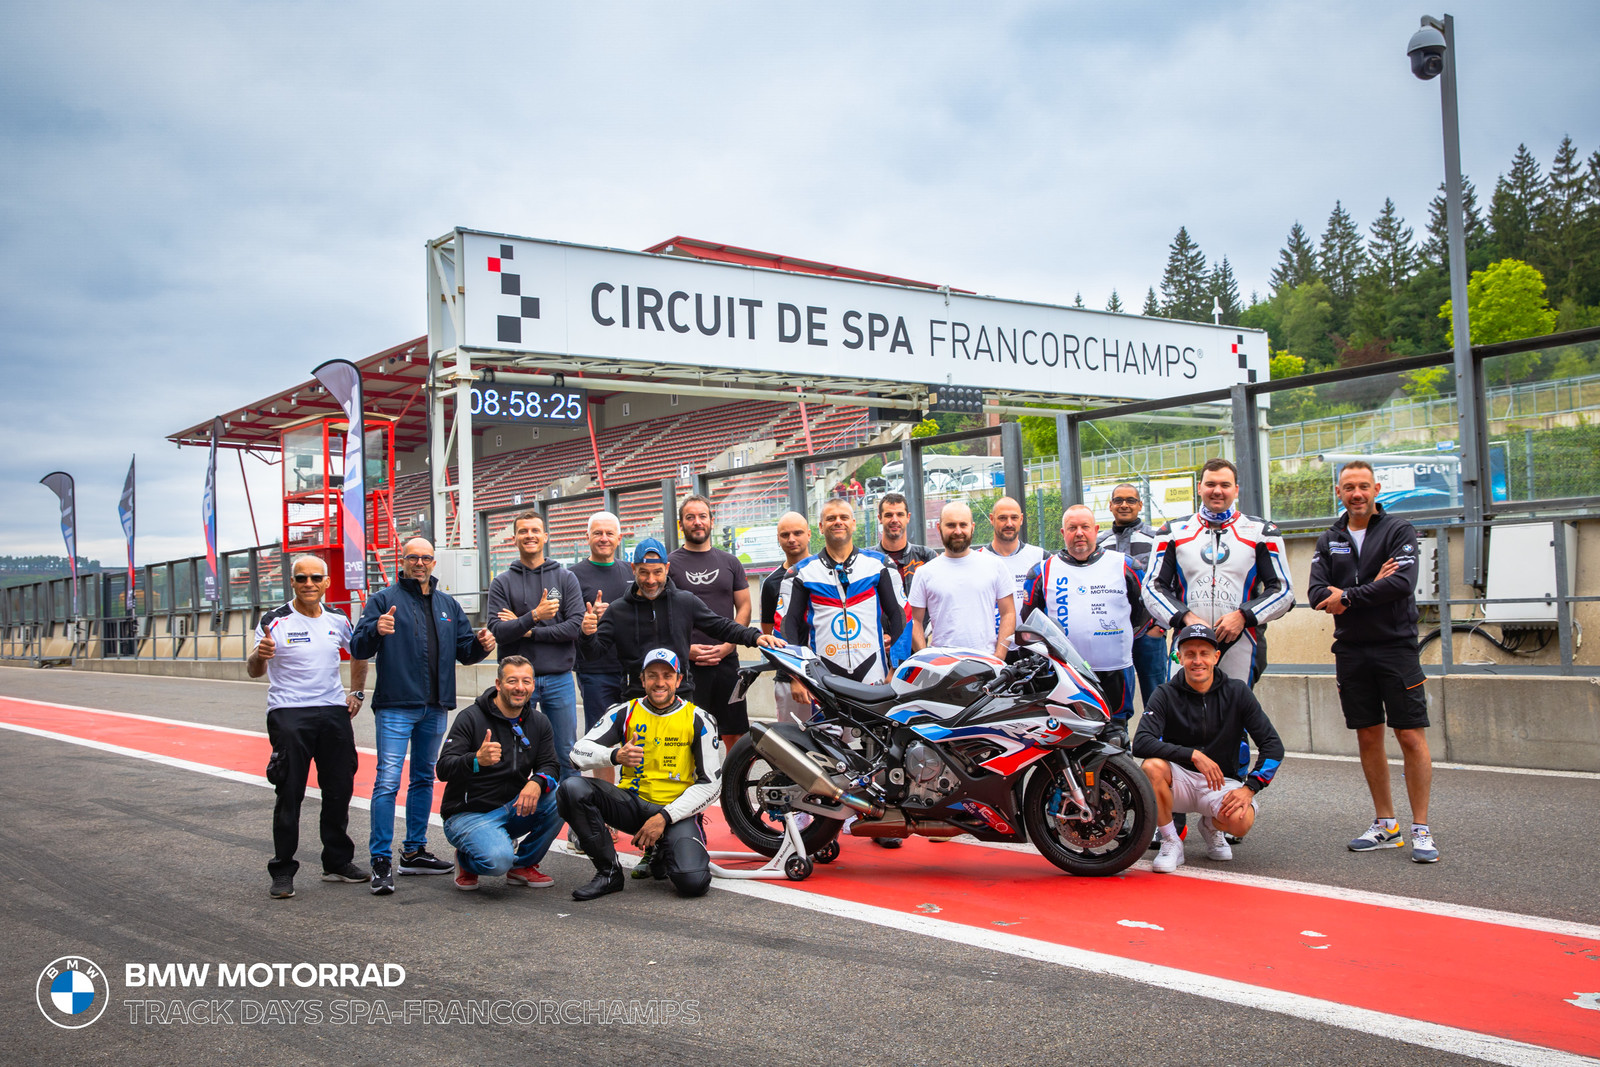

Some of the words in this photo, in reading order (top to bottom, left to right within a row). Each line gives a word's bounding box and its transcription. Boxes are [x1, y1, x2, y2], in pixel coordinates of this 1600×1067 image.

[590, 282, 763, 340] CIRCUIT
[777, 302, 829, 347] DE
[842, 310, 914, 355] SPA
[929, 319, 1198, 380] FRANCORCHAMPS
[471, 388, 582, 419] 08:58:25
[1190, 590, 1237, 601] EVASION
[836, 643, 871, 651] Location
